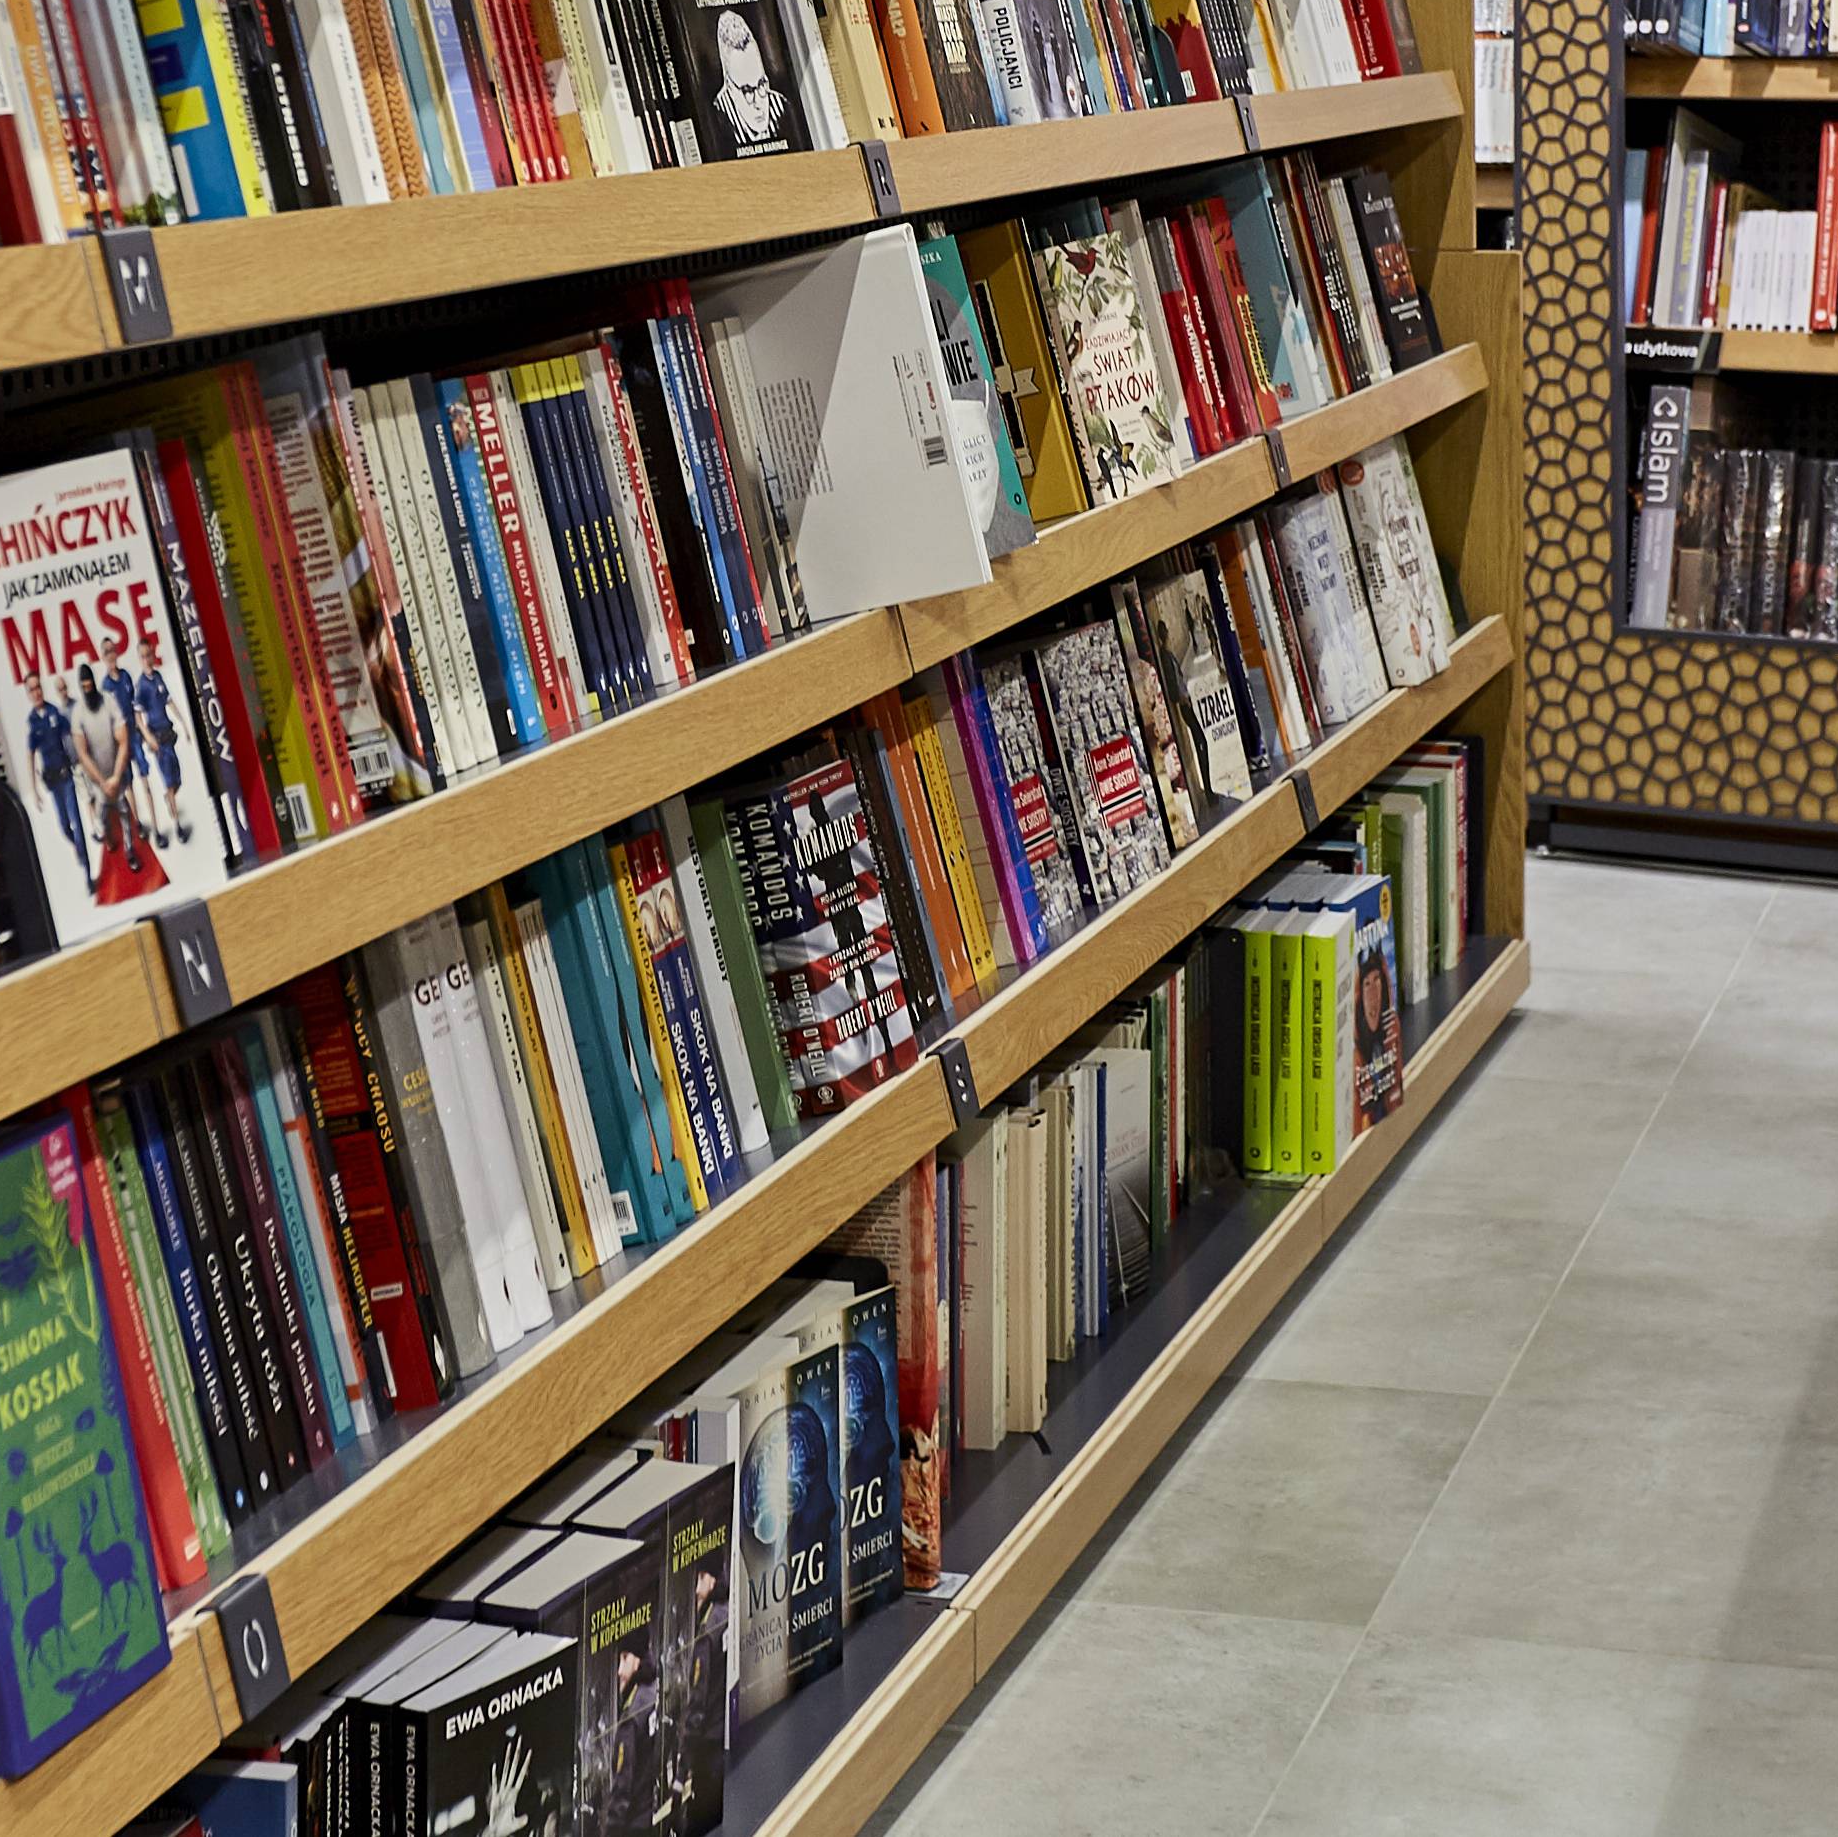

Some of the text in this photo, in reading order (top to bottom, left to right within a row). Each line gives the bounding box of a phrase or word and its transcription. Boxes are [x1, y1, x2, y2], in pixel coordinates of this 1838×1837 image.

[995, 6, 1024, 91] POLICJANCI
[873, 158, 892, 197] R
[1084, 328, 1134, 353] ZADZIWIAJĄCY
[1094, 349, 1136, 377] ŚWIAT
[1633, 341, 1699, 362] użytkowa
[1086, 375, 1157, 414] PTAKÓW
[1645, 422, 1680, 503] Islam
[712, 490, 729, 536] DROGA
[721, 487, 738, 533] DROGA
[474, 402, 555, 689] MELLER MIĘDZY WARIATAMI
[2, 551, 132, 608] JAK ZAMKNĄŁEM
[166, 541, 235, 763] MAZEL TOW
[1196, 686, 1235, 729] IZRAEL
[745, 803, 793, 922] KOMANDOS
[793, 816, 859, 871] KOMANDOS
[790, 973, 826, 1077] ROBERT O'NEILL
[835, 989, 898, 1042] ROBERT O'NEILL
[670, 1020, 716, 1176] SKOK NA BANKI
[690, 1007, 734, 1160] SKOK NA BANKI
[277, 1166, 316, 1308] PTAKOLOGIA
[329, 1173, 372, 1329] MISJA HELIKOPTER
[233, 1231, 283, 1415] Ukryta róża
[264, 1217, 318, 1416] Pocałunki piasku
[852, 1302, 891, 1330] OWEN
[178, 1267, 229, 1438] Burka miłości
[206, 1252, 260, 1442] Okrutna miłość
[671, 1518, 705, 1555] STRZAŁY
[672, 1525, 727, 1575] W KOPENHADZE
[853, 1527, 894, 1565] ŚMIERCI
[589, 1596, 628, 1634] STRZAŁY
[590, 1601, 652, 1655] W KOPENHADZE
[241, 1617, 272, 1681] O
[444, 1665, 566, 1744] EWA ORNACKA
[405, 1724, 417, 1752] EWA
